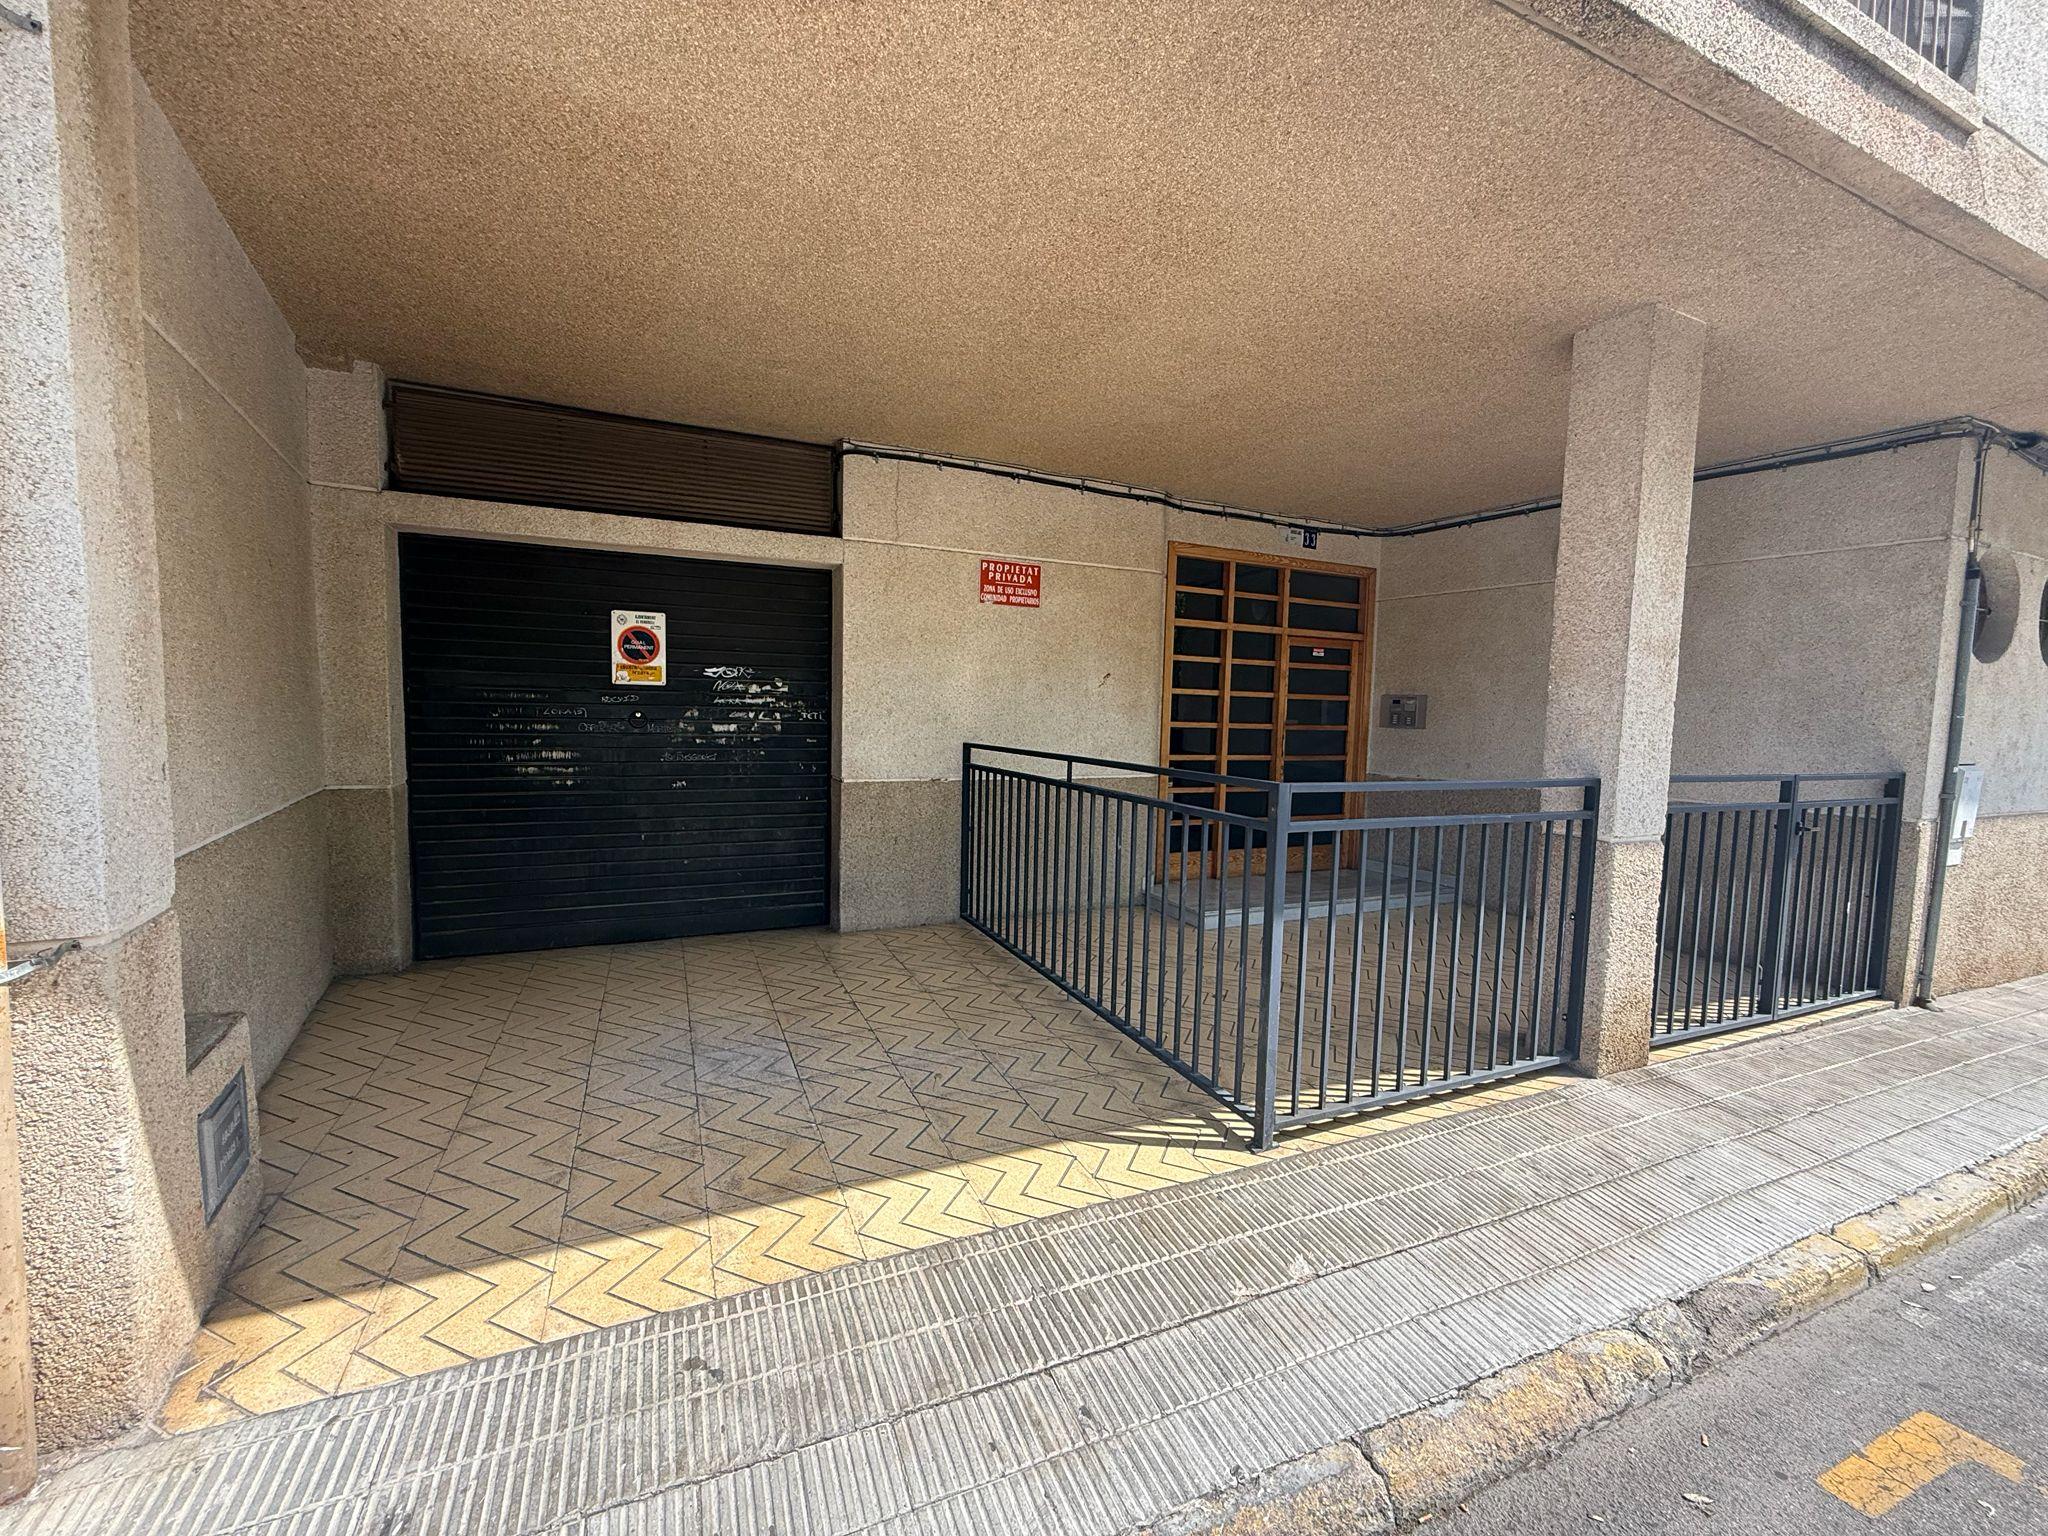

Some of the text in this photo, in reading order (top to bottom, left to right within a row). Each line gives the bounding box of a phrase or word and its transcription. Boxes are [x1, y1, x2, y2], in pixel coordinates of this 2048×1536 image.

[1304, 532, 1316, 547] 33
[982, 562, 1039, 576] PROPIETAT
[988, 571, 1033, 584] PRIVADA
[983, 584, 996, 593] ZONA
[997, 585, 1004, 594] DE
[1004, 586, 1014, 595] USO
